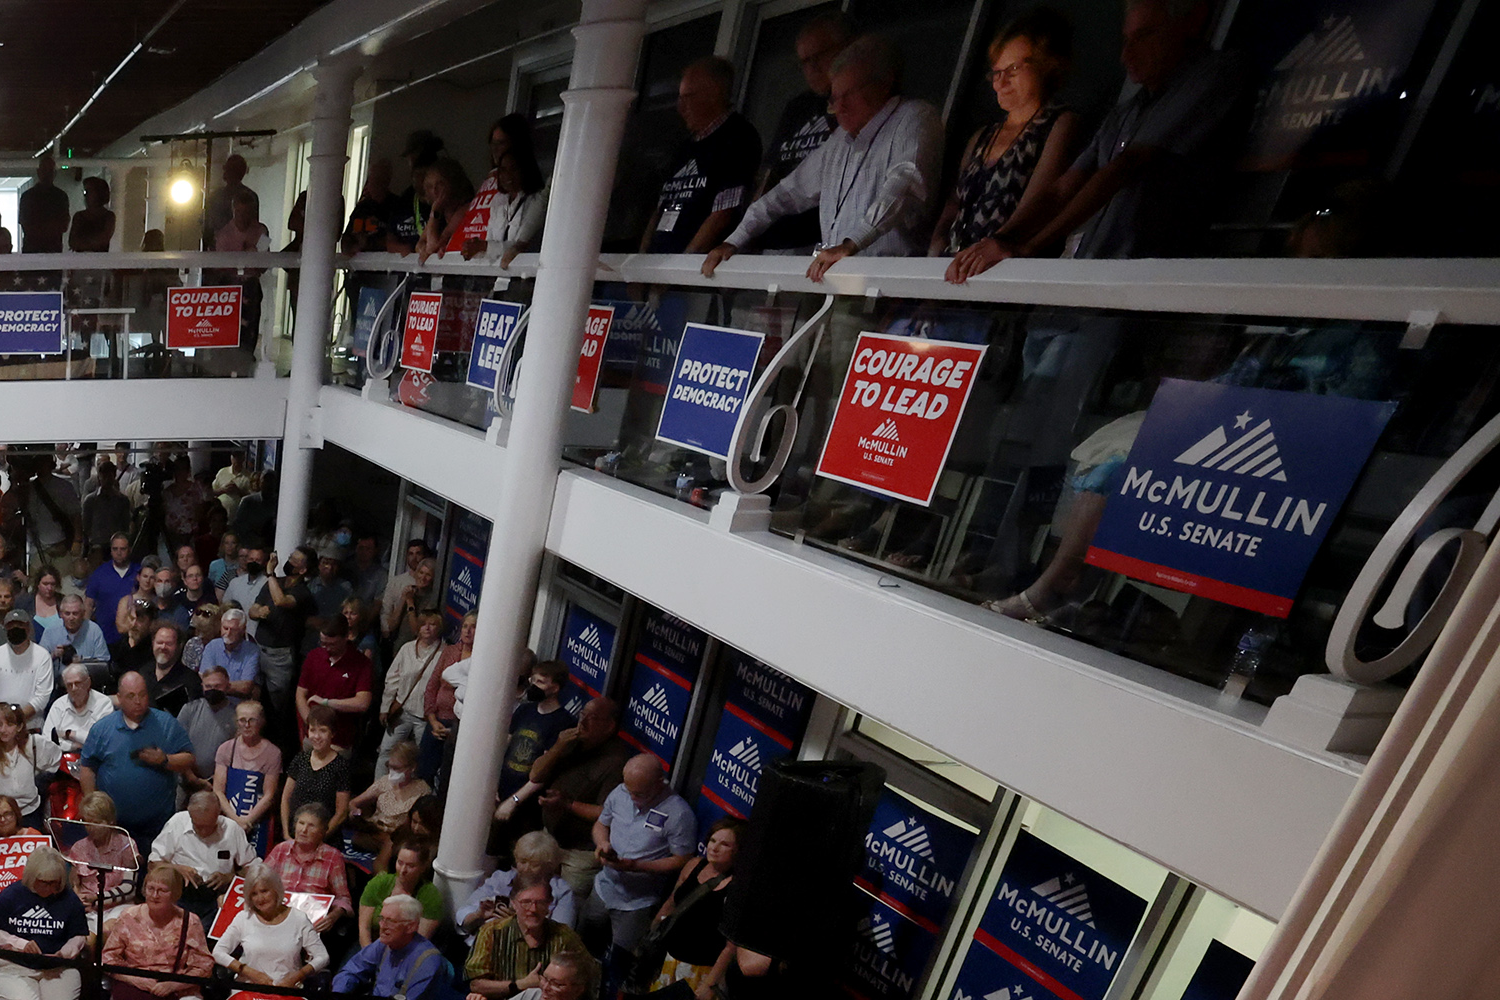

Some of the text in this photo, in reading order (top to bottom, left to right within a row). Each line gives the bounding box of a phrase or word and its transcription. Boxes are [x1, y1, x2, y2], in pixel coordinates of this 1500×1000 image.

[170, 291, 238, 305] COURAGE
[175, 305, 234, 318] TO LEAD
[409, 300, 439, 315] COURAGE
[408, 316, 434, 332] TO LEAD
[478, 312, 514, 340] BEAT
[678, 358, 749, 392] PROTECT
[853, 347, 972, 389] COURAGE
[673, 384, 742, 414] DEMOCRACY
[850, 380, 949, 420] TO LEAD
[857, 437, 908, 459] McMULLIN
[876, 455, 895, 467] SENATE
[1120, 467, 1327, 537] McMULLIN
[1138, 511, 1263, 558] U.S. SENATE
[450, 579, 478, 606] McMULLIN
[646, 616, 700, 656] McMULLIN
[567, 637, 609, 673] McMULLIN
[580, 661, 599, 679] SENATE
[736, 661, 804, 712] McMULLIN
[628, 696, 679, 741] McMULLIN
[755, 694, 784, 719] SENATE
[634, 718, 666, 746] U.S. SENATE
[711, 749, 759, 793] McMULL
[717, 773, 729, 787] U.S.
[888, 869, 927, 901] SENATE
[8, 917, 65, 930] McMULLIN
[29, 928, 54, 936] SENATE
[998, 882, 1118, 971] McMULLIN
[1010, 917, 1083, 973] U.S. SENATE
